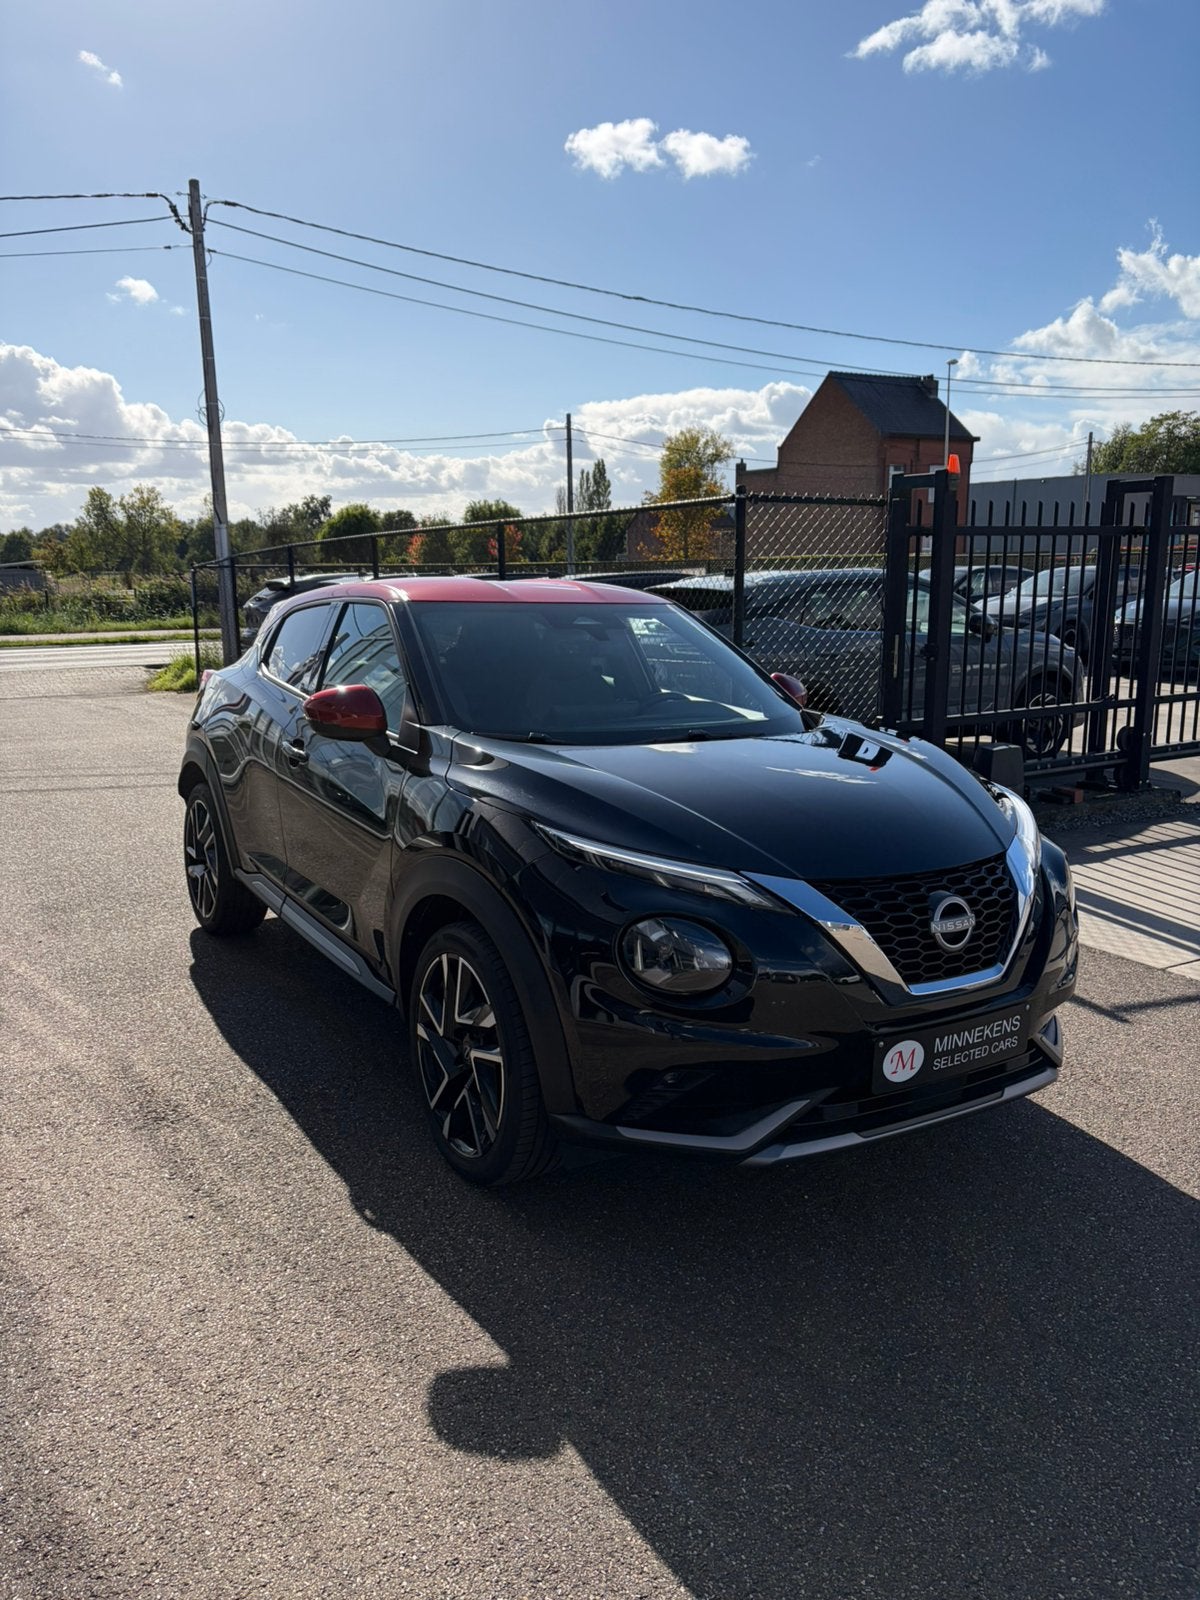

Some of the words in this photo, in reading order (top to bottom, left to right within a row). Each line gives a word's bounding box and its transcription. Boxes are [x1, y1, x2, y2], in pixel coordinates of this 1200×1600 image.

[931, 917, 976, 933] NISSAN
[933, 1015, 1021, 1053] MINNEKENS
[890, 1047, 916, 1075] M
[932, 1043, 989, 1071] SELECTED
[991, 1035, 1018, 1054] CARS
